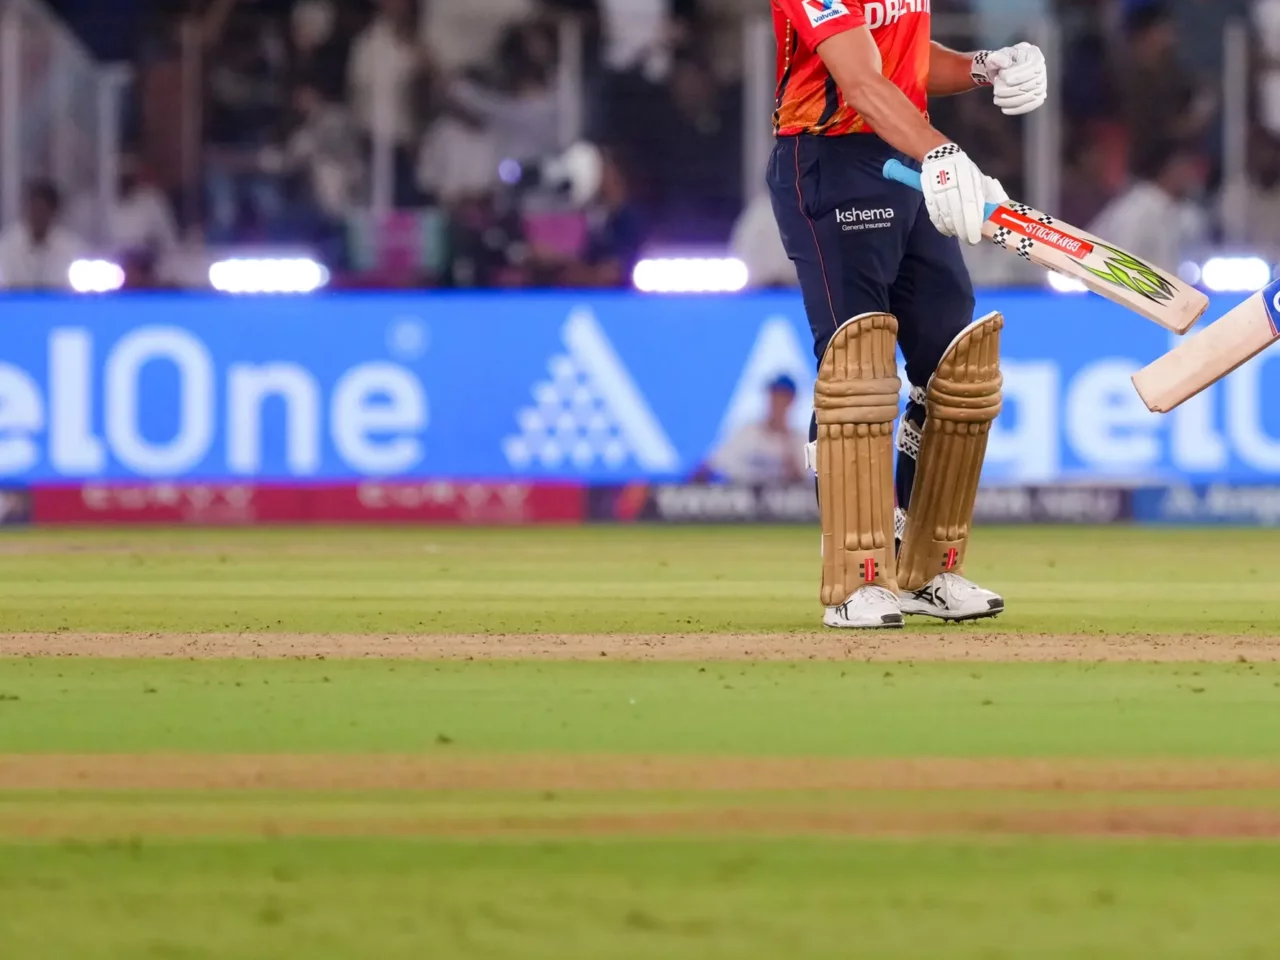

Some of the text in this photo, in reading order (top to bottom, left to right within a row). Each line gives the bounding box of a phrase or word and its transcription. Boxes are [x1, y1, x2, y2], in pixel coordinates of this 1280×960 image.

[835, 207, 895, 223] kshema
[842, 223, 864, 231] General
[1025, 223, 1082, 253] GRAY-NICOLLS
